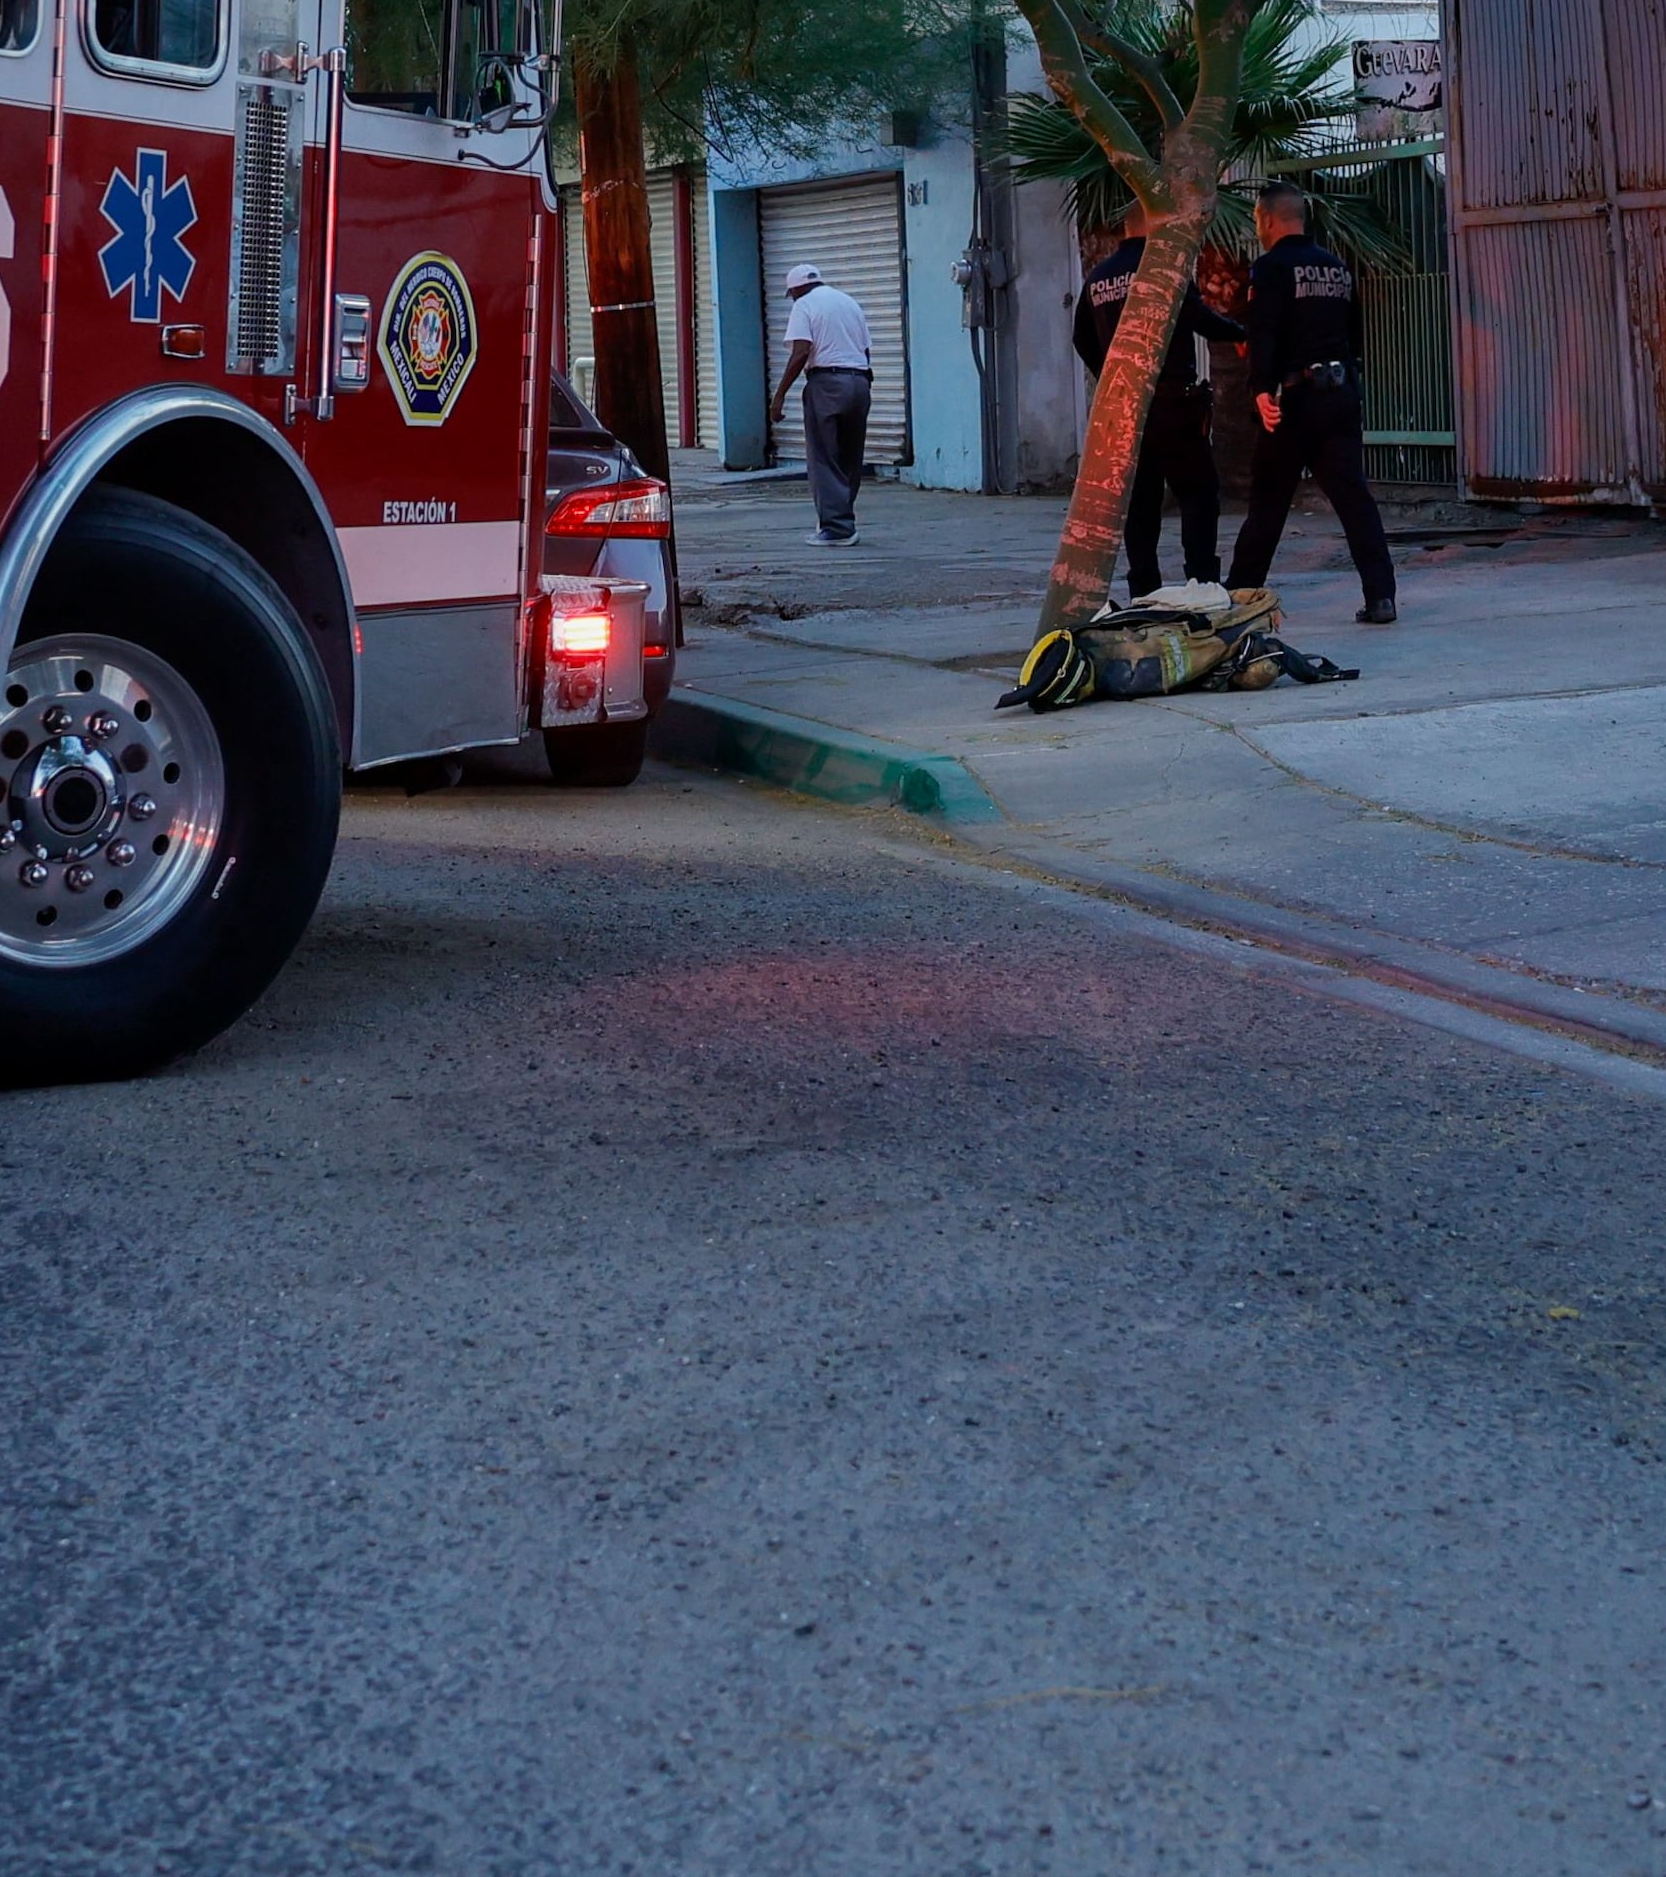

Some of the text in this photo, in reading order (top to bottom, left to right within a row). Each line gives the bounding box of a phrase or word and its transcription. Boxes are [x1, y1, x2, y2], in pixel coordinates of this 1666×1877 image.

[389, 340, 418, 404] MEXICALI
[436, 352, 465, 406] MEXICO
[586, 465, 609, 475] SV
[383, 496, 457, 523] ESTACIÓN 1
